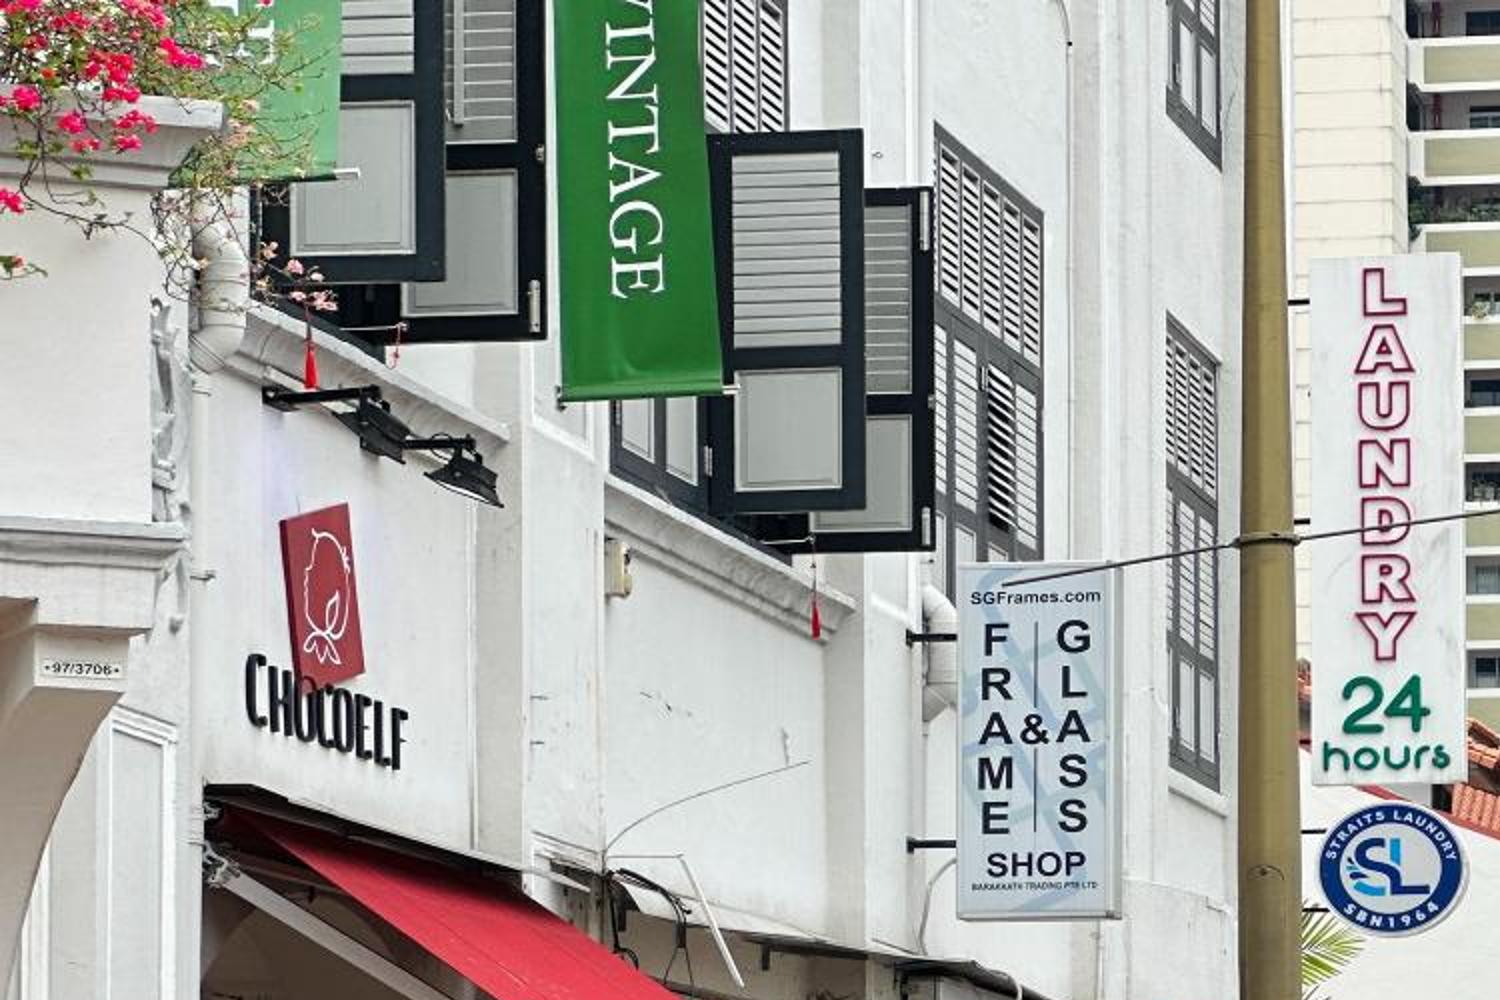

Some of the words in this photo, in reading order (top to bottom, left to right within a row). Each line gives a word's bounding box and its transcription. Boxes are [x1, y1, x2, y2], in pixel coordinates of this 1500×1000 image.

[1354, 267, 1417, 662] LAUNDRY
[970, 590, 1101, 606] SGFrames.com
[245, 653, 409, 771] CHOCOELF
[978, 622, 1013, 835] FRAME
[1020, 713, 1050, 745] &
[1056, 619, 1091, 833] GLASS
[1342, 674, 1431, 735] 24
[1322, 741, 1451, 773] hours
[1325, 810, 1385, 860] STRAITS
[1393, 810, 1457, 860] LAUNDRY
[986, 851, 1087, 878] SHOP
